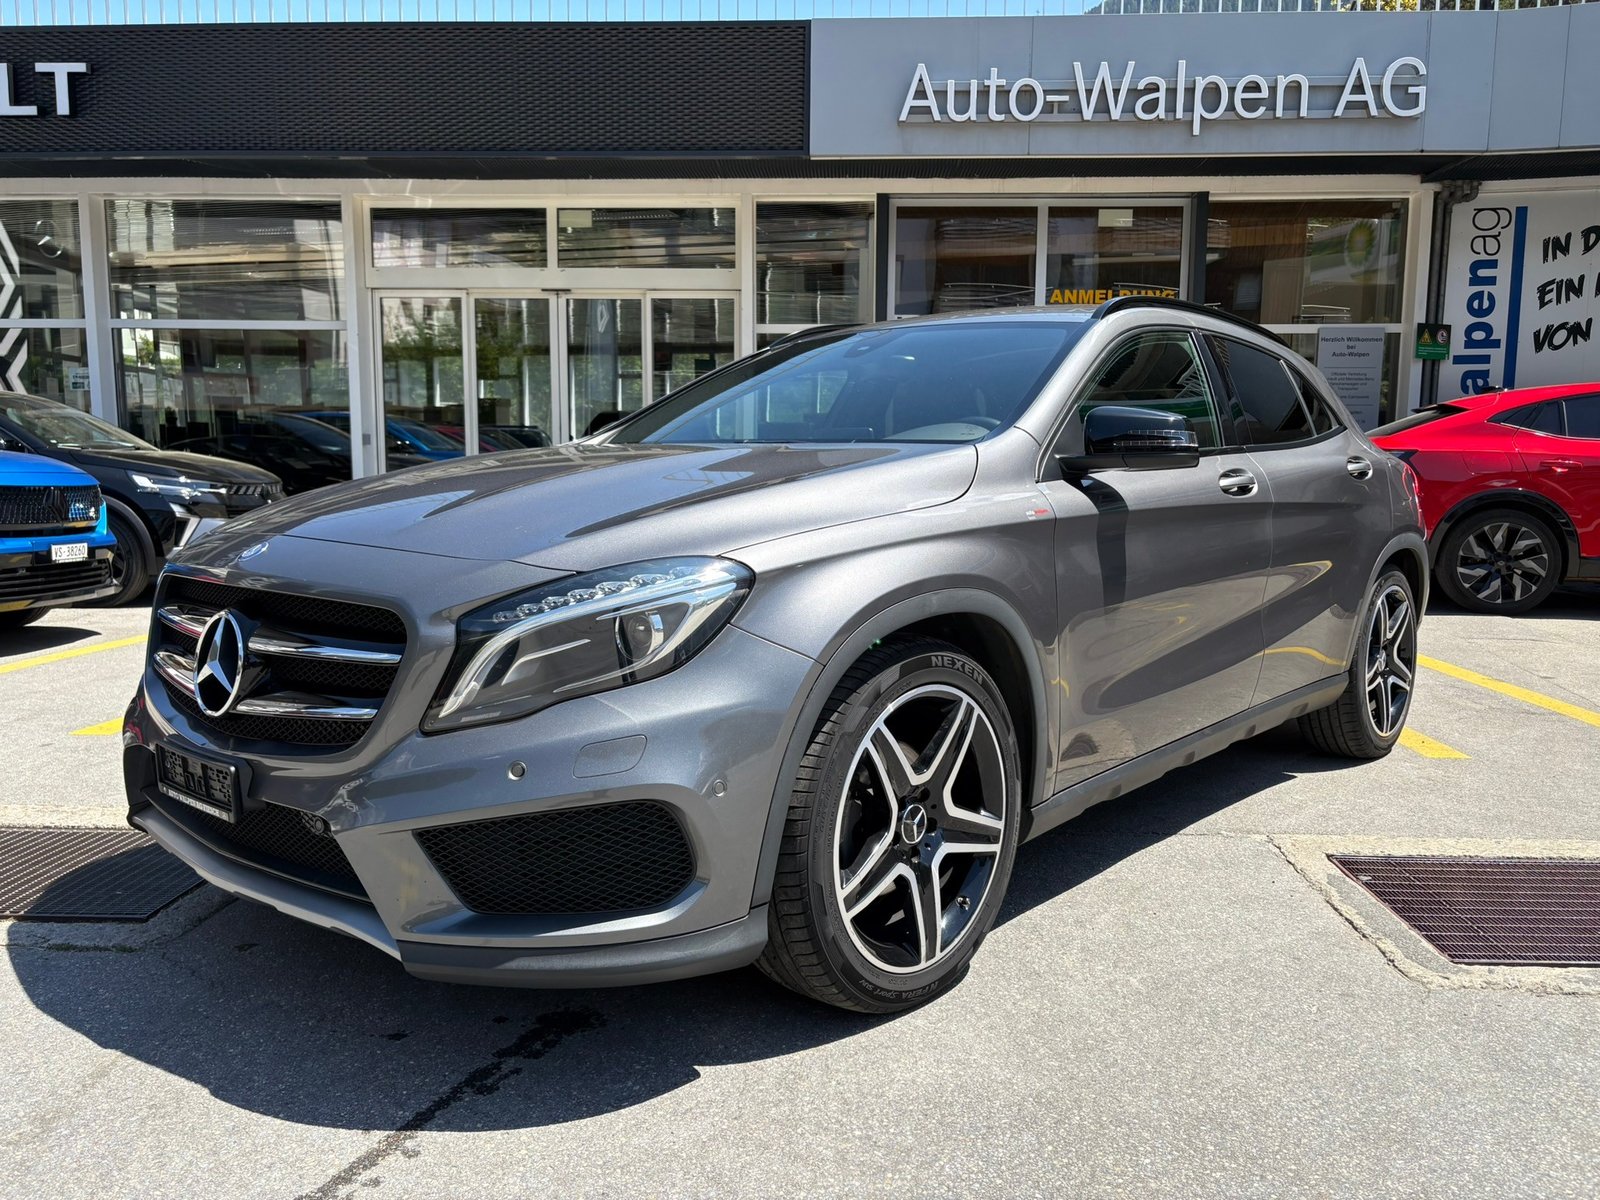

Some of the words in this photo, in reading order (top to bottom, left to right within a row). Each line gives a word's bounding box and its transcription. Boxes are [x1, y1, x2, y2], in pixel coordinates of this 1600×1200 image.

[898, 58, 1309, 136] Auto-Walpen
[1333, 56, 1428, 119] AG
[1542, 231, 1572, 264] IN
[1536, 273, 1585, 310] EIN
[1532, 317, 1593, 354] VON
[931, 655, 984, 685] NEXEN
